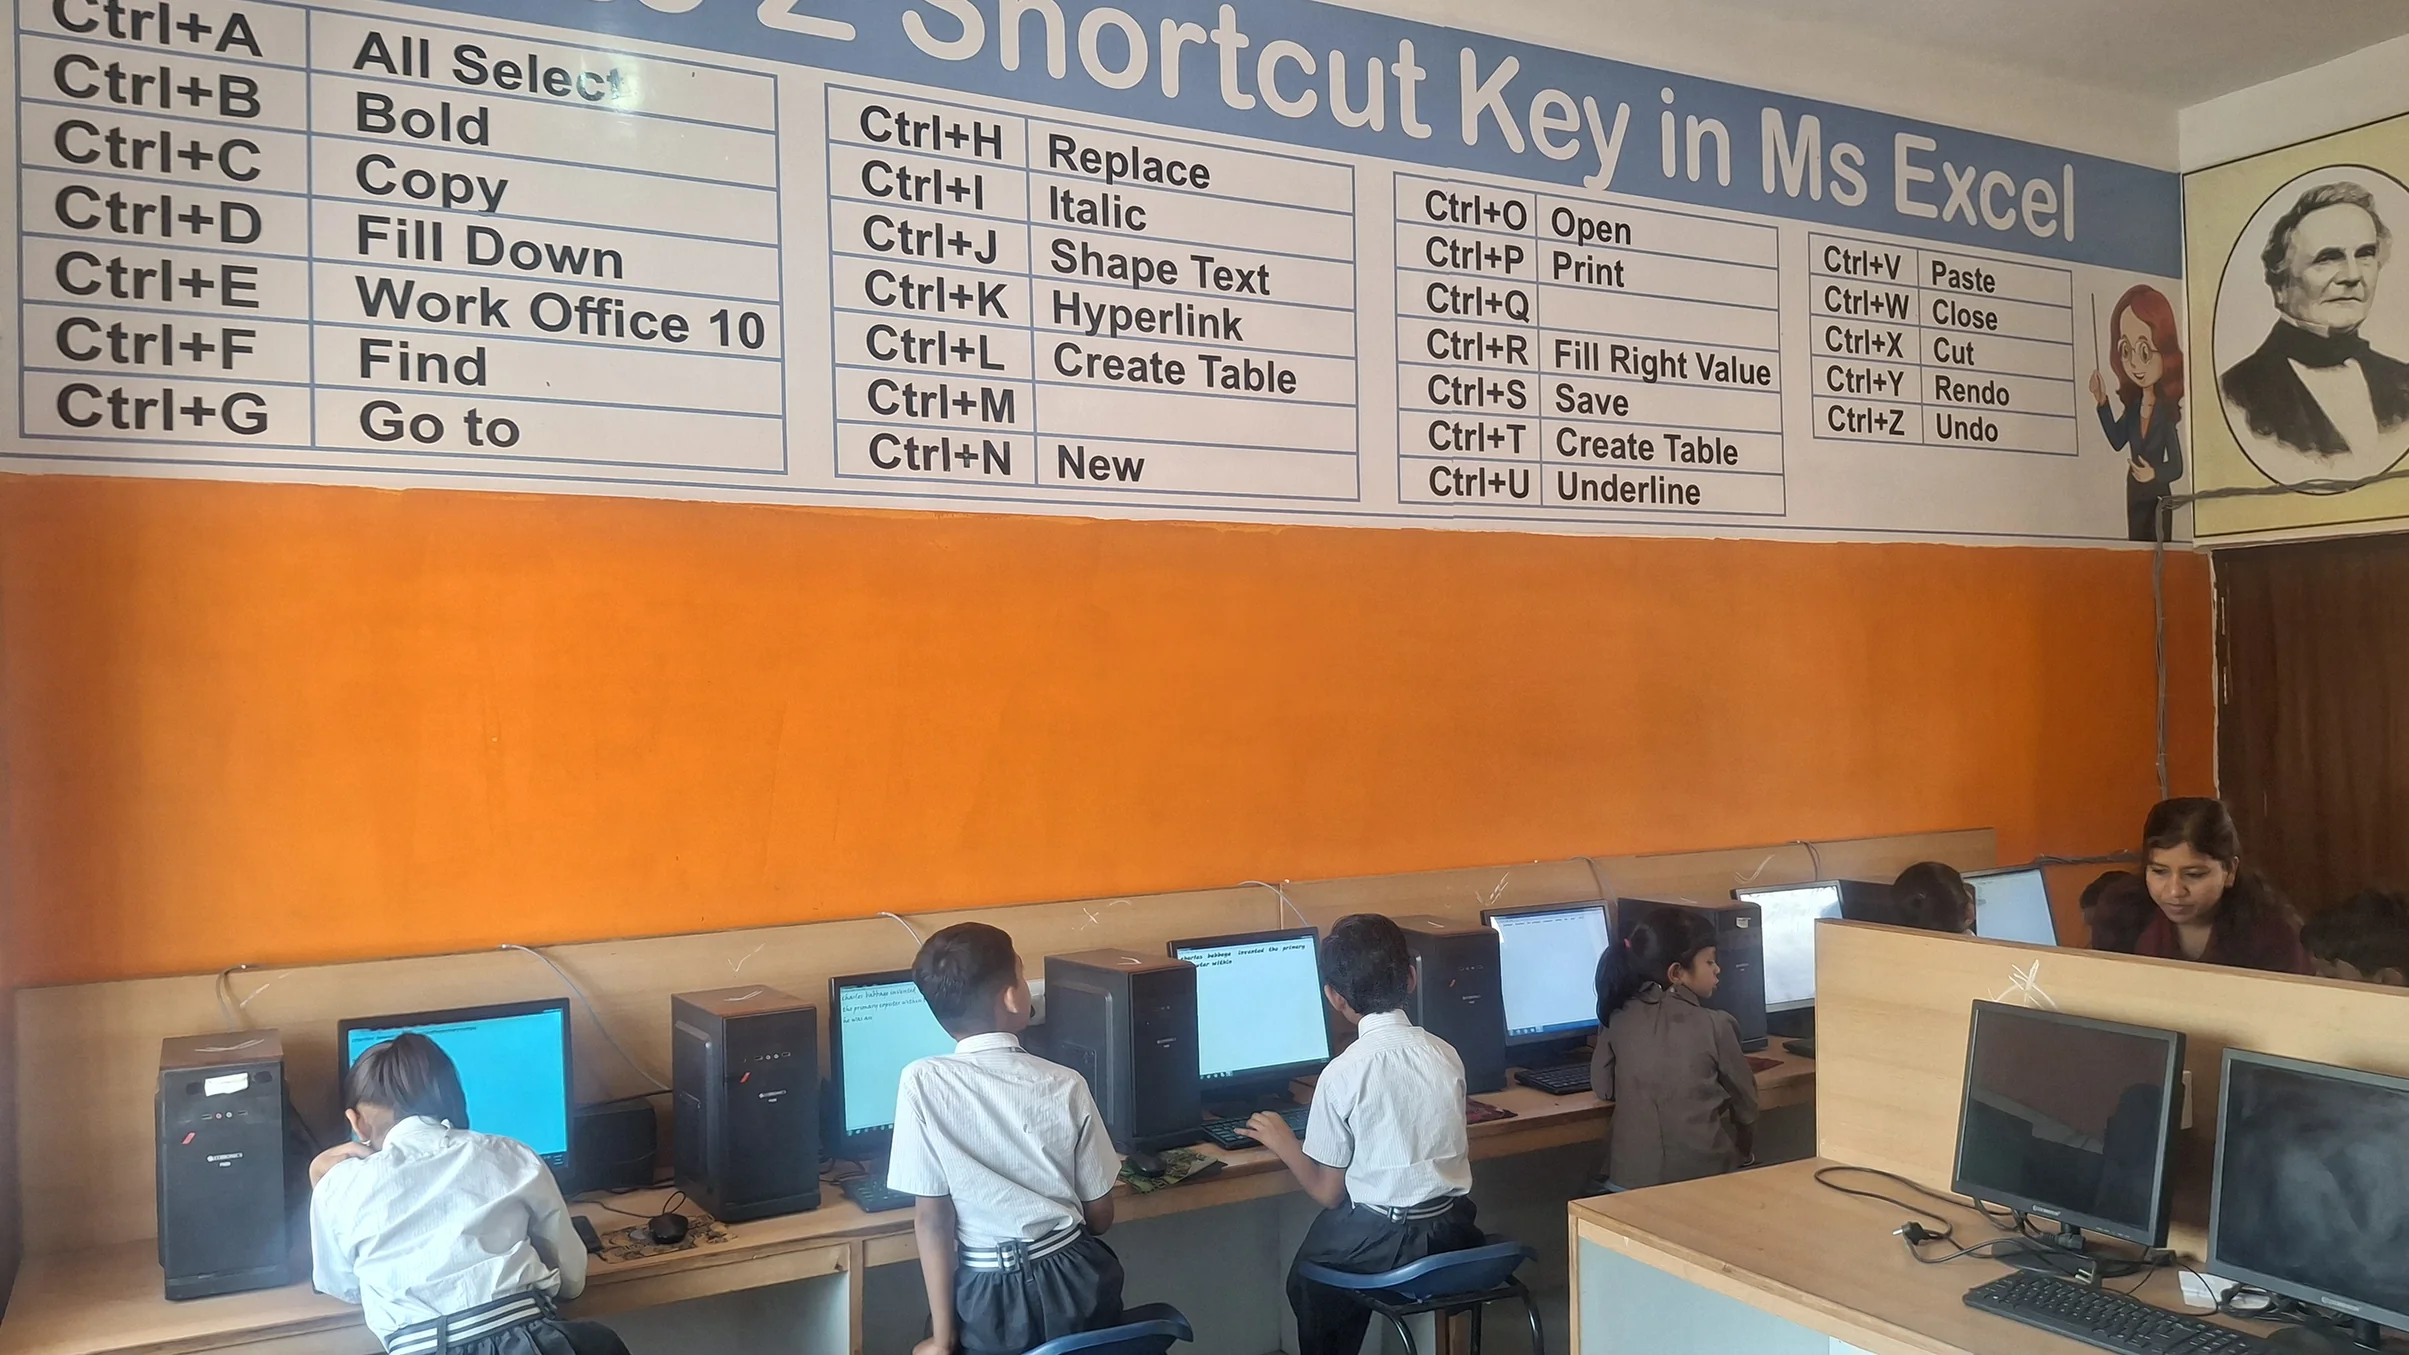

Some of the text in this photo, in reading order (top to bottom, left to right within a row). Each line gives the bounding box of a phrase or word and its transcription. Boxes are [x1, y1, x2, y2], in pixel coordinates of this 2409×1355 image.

[53, 0, 262, 56] Ctrl+A
[54, 54, 260, 117] Ctrl+B
[354, 32, 626, 101] All Select
[358, 92, 488, 145] Bold
[861, 106, 1001, 159] Ctrl+H
[55, 120, 259, 181] Ctrl+C
[1050, 134, 1209, 188] Replace
[1460, 47, 1629, 189] Key
[1660, 86, 1731, 187] in
[1761, 106, 1868, 207] Ms
[1894, 132, 2075, 243] Excel
[357, 155, 507, 212] Copy
[862, 161, 982, 209] Ctrl+I
[56, 186, 261, 243] Ctrl+D
[1051, 186, 1145, 230] Italic
[1426, 190, 1526, 230] Ctrl+O
[1552, 208, 1630, 246] Open
[359, 215, 622, 278] Fill Down
[864, 215, 995, 263] Ctrl+J
[1427, 237, 1523, 273] Ctrl+P
[56, 251, 258, 307] Ctrl+E
[1052, 239, 1269, 295] Shape Text
[1554, 251, 1624, 287] Print
[1825, 246, 1900, 279] Ctrl+V
[1932, 261, 1996, 291] Paste
[356, 276, 763, 348] Work Office 10
[866, 270, 1007, 318] Ctrl+K
[1054, 291, 1242, 340] Hyperlink
[1427, 283, 1529, 322] Ctrl+Q
[1825, 286, 1908, 319] Ctrl+W
[1933, 299, 1998, 331] Close
[57, 317, 255, 369] Ctrl+F
[361, 339, 485, 385] Find
[867, 325, 1004, 370] Ctrl+L
[1428, 329, 1527, 364] Ctrl+R
[1556, 340, 1770, 385] Fill Right Value
[1826, 326, 1903, 358] Ctrl+X
[1934, 338, 1974, 365] Cut
[1055, 343, 1296, 393] Create Table
[1827, 365, 1903, 396] Ctrl+Y
[57, 383, 266, 434] Ctrl+G
[869, 379, 1013, 422] Ctrl+M
[1429, 375, 1526, 409] Ctrl+S
[1557, 384, 1628, 416] Save
[1936, 376, 2009, 405] Rendo
[361, 401, 518, 447] Go to
[1429, 421, 1525, 453] Ctrl+T
[1829, 405, 1904, 435] Ctrl+Z
[1937, 413, 1998, 442] Undo
[870, 434, 1010, 474] Ctrl+N
[1059, 446, 1144, 481] New
[1557, 428, 1737, 465] Create Table
[1430, 466, 1528, 498] Ctrl+U
[1559, 472, 1700, 505] Underline
[1238, 947, 1264, 955] invented
[1282, 943, 1305, 952] primary
